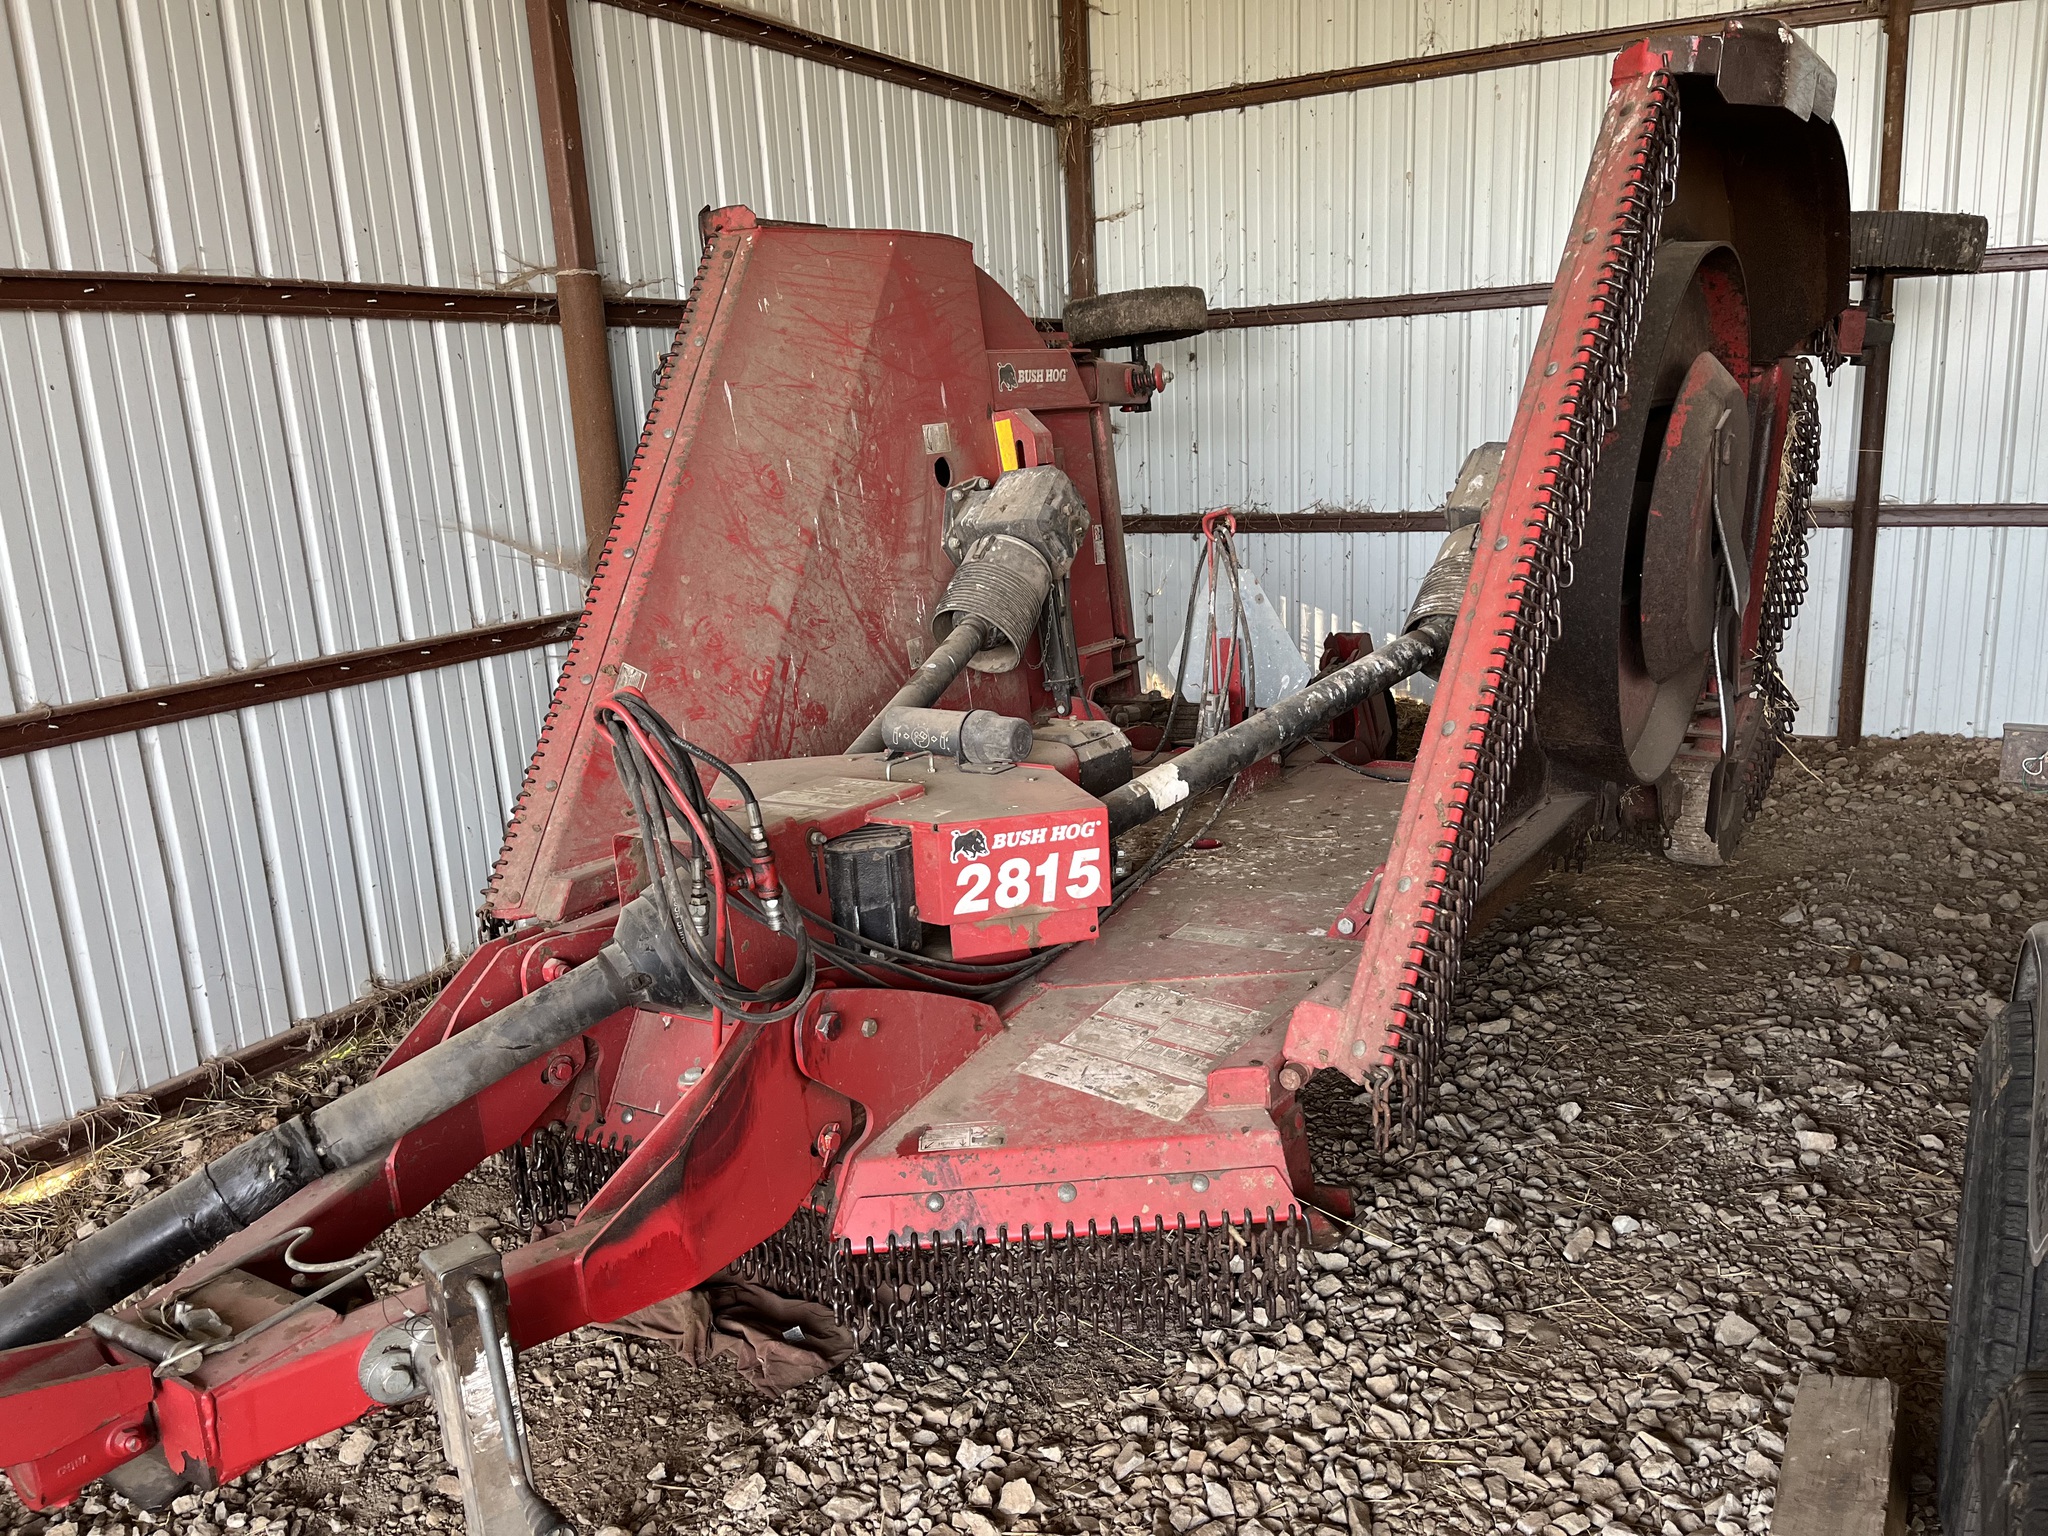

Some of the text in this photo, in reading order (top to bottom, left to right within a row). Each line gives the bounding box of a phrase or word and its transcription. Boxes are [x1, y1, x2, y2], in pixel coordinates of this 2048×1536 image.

[1018, 368, 1067, 383] BUSH HOG
[671, 735, 693, 751] HOSE
[694, 748, 736, 778] HYDRAULIC
[992, 821, 1097, 850] BUSH HOG
[953, 848, 1101, 915] 2815
